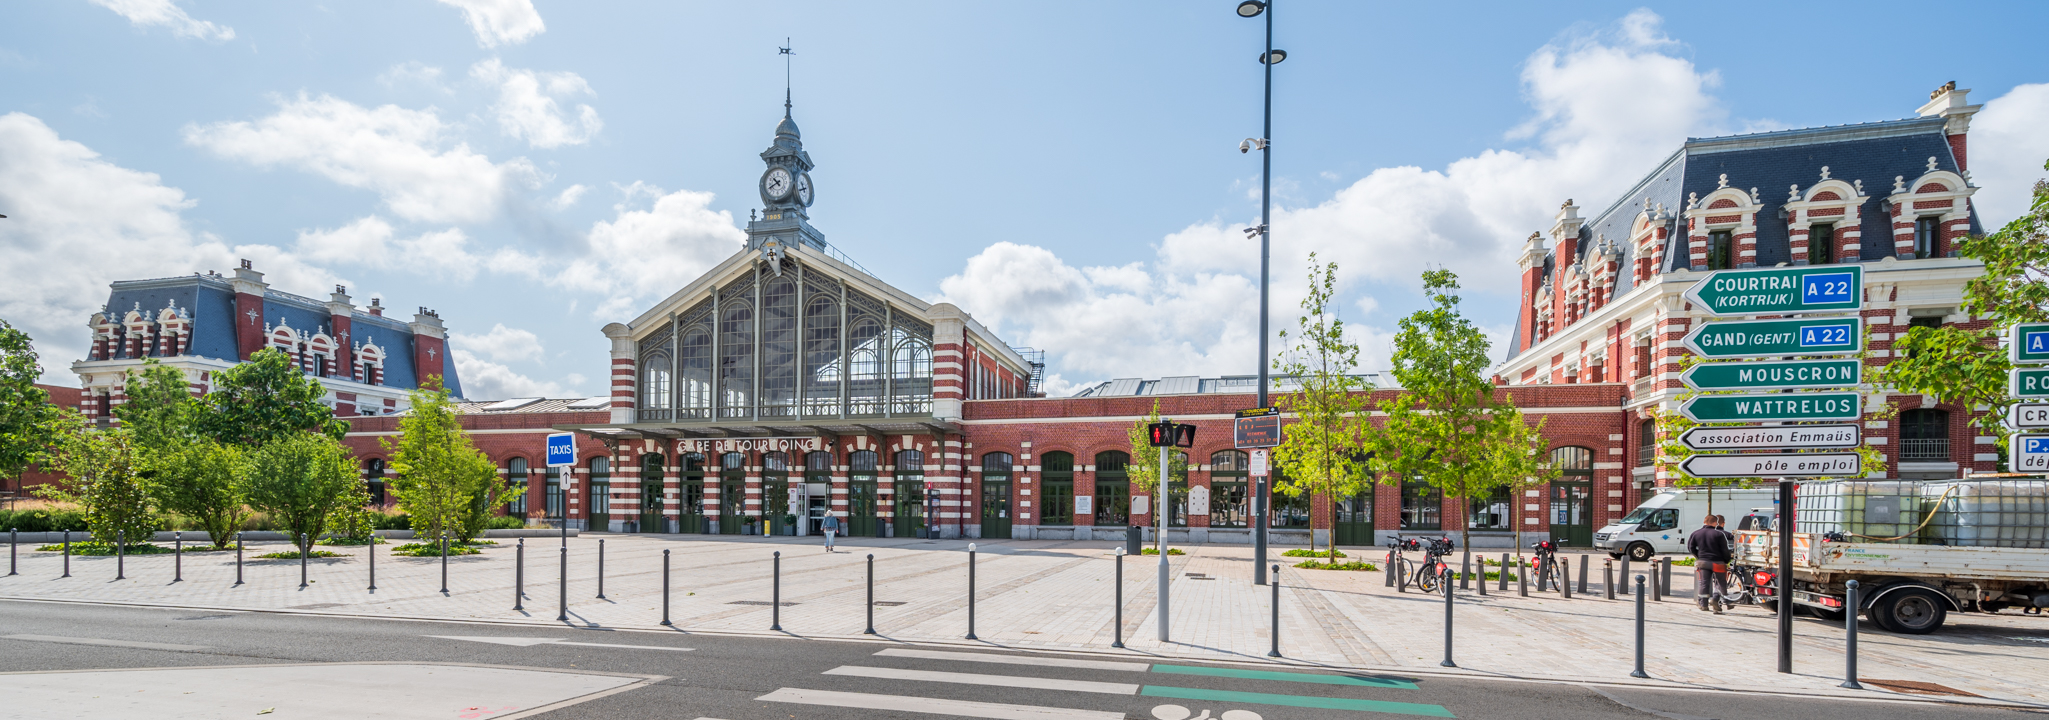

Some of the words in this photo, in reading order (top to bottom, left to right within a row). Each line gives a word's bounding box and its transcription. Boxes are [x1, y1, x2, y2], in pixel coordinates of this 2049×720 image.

[1715, 276, 1797, 292] COURTRAI
[1808, 283, 1818, 296] A
[1824, 281, 1848, 295] 22
[1715, 293, 1794, 308] (KORTRIJK)
[1702, 332, 1746, 347] GAND
[1749, 332, 1796, 346] (GENT)
[1805, 329, 1816, 343] A
[1822, 328, 1846, 343] 22
[2032, 335, 2043, 350] A
[1739, 366, 1851, 382] MOUSCRON
[1735, 399, 1851, 415] WATTRELOS
[1700, 432, 1783, 444] association
[1790, 431, 1852, 443] Emmaüs
[550, 445, 572, 455] TAXIS
[678, 441, 710, 451] GARE
[715, 441, 729, 451] DE
[735, 440, 815, 451] TOURCOING
[1754, 460, 1788, 473] pôle
[1798, 459, 1854, 472] emploi
[2025, 455, 2049, 469] dé
